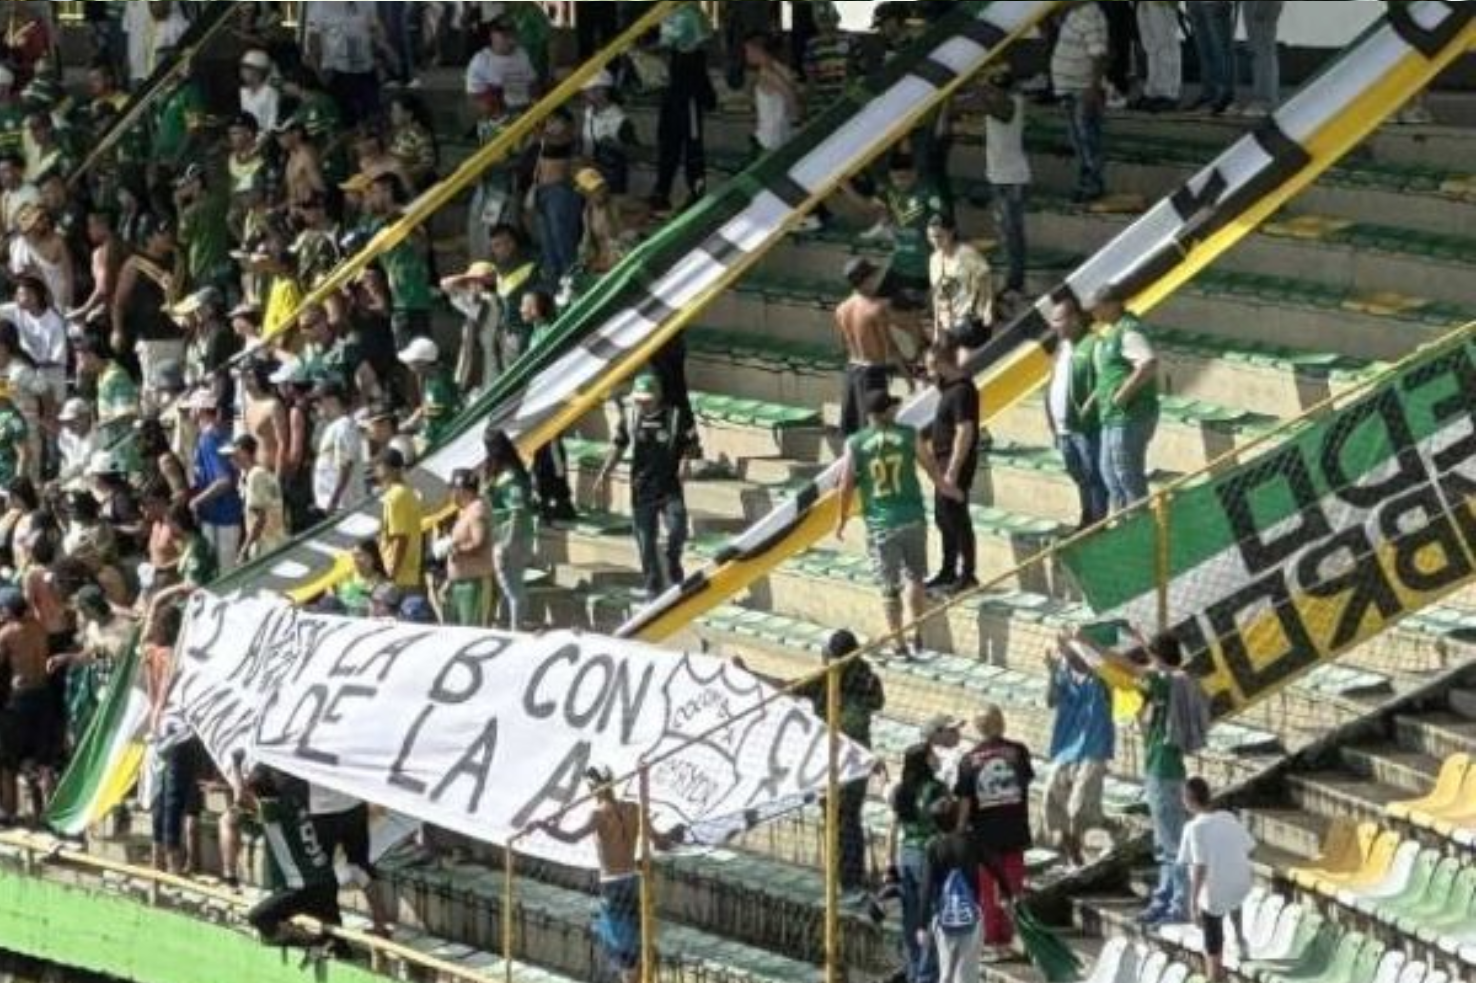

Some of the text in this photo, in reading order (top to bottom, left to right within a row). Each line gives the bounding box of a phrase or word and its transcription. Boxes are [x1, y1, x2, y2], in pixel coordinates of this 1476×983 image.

[869, 453, 903, 498] 27
[428, 635, 513, 704] B
[522, 643, 655, 746] CON
[387, 703, 498, 814] LA
